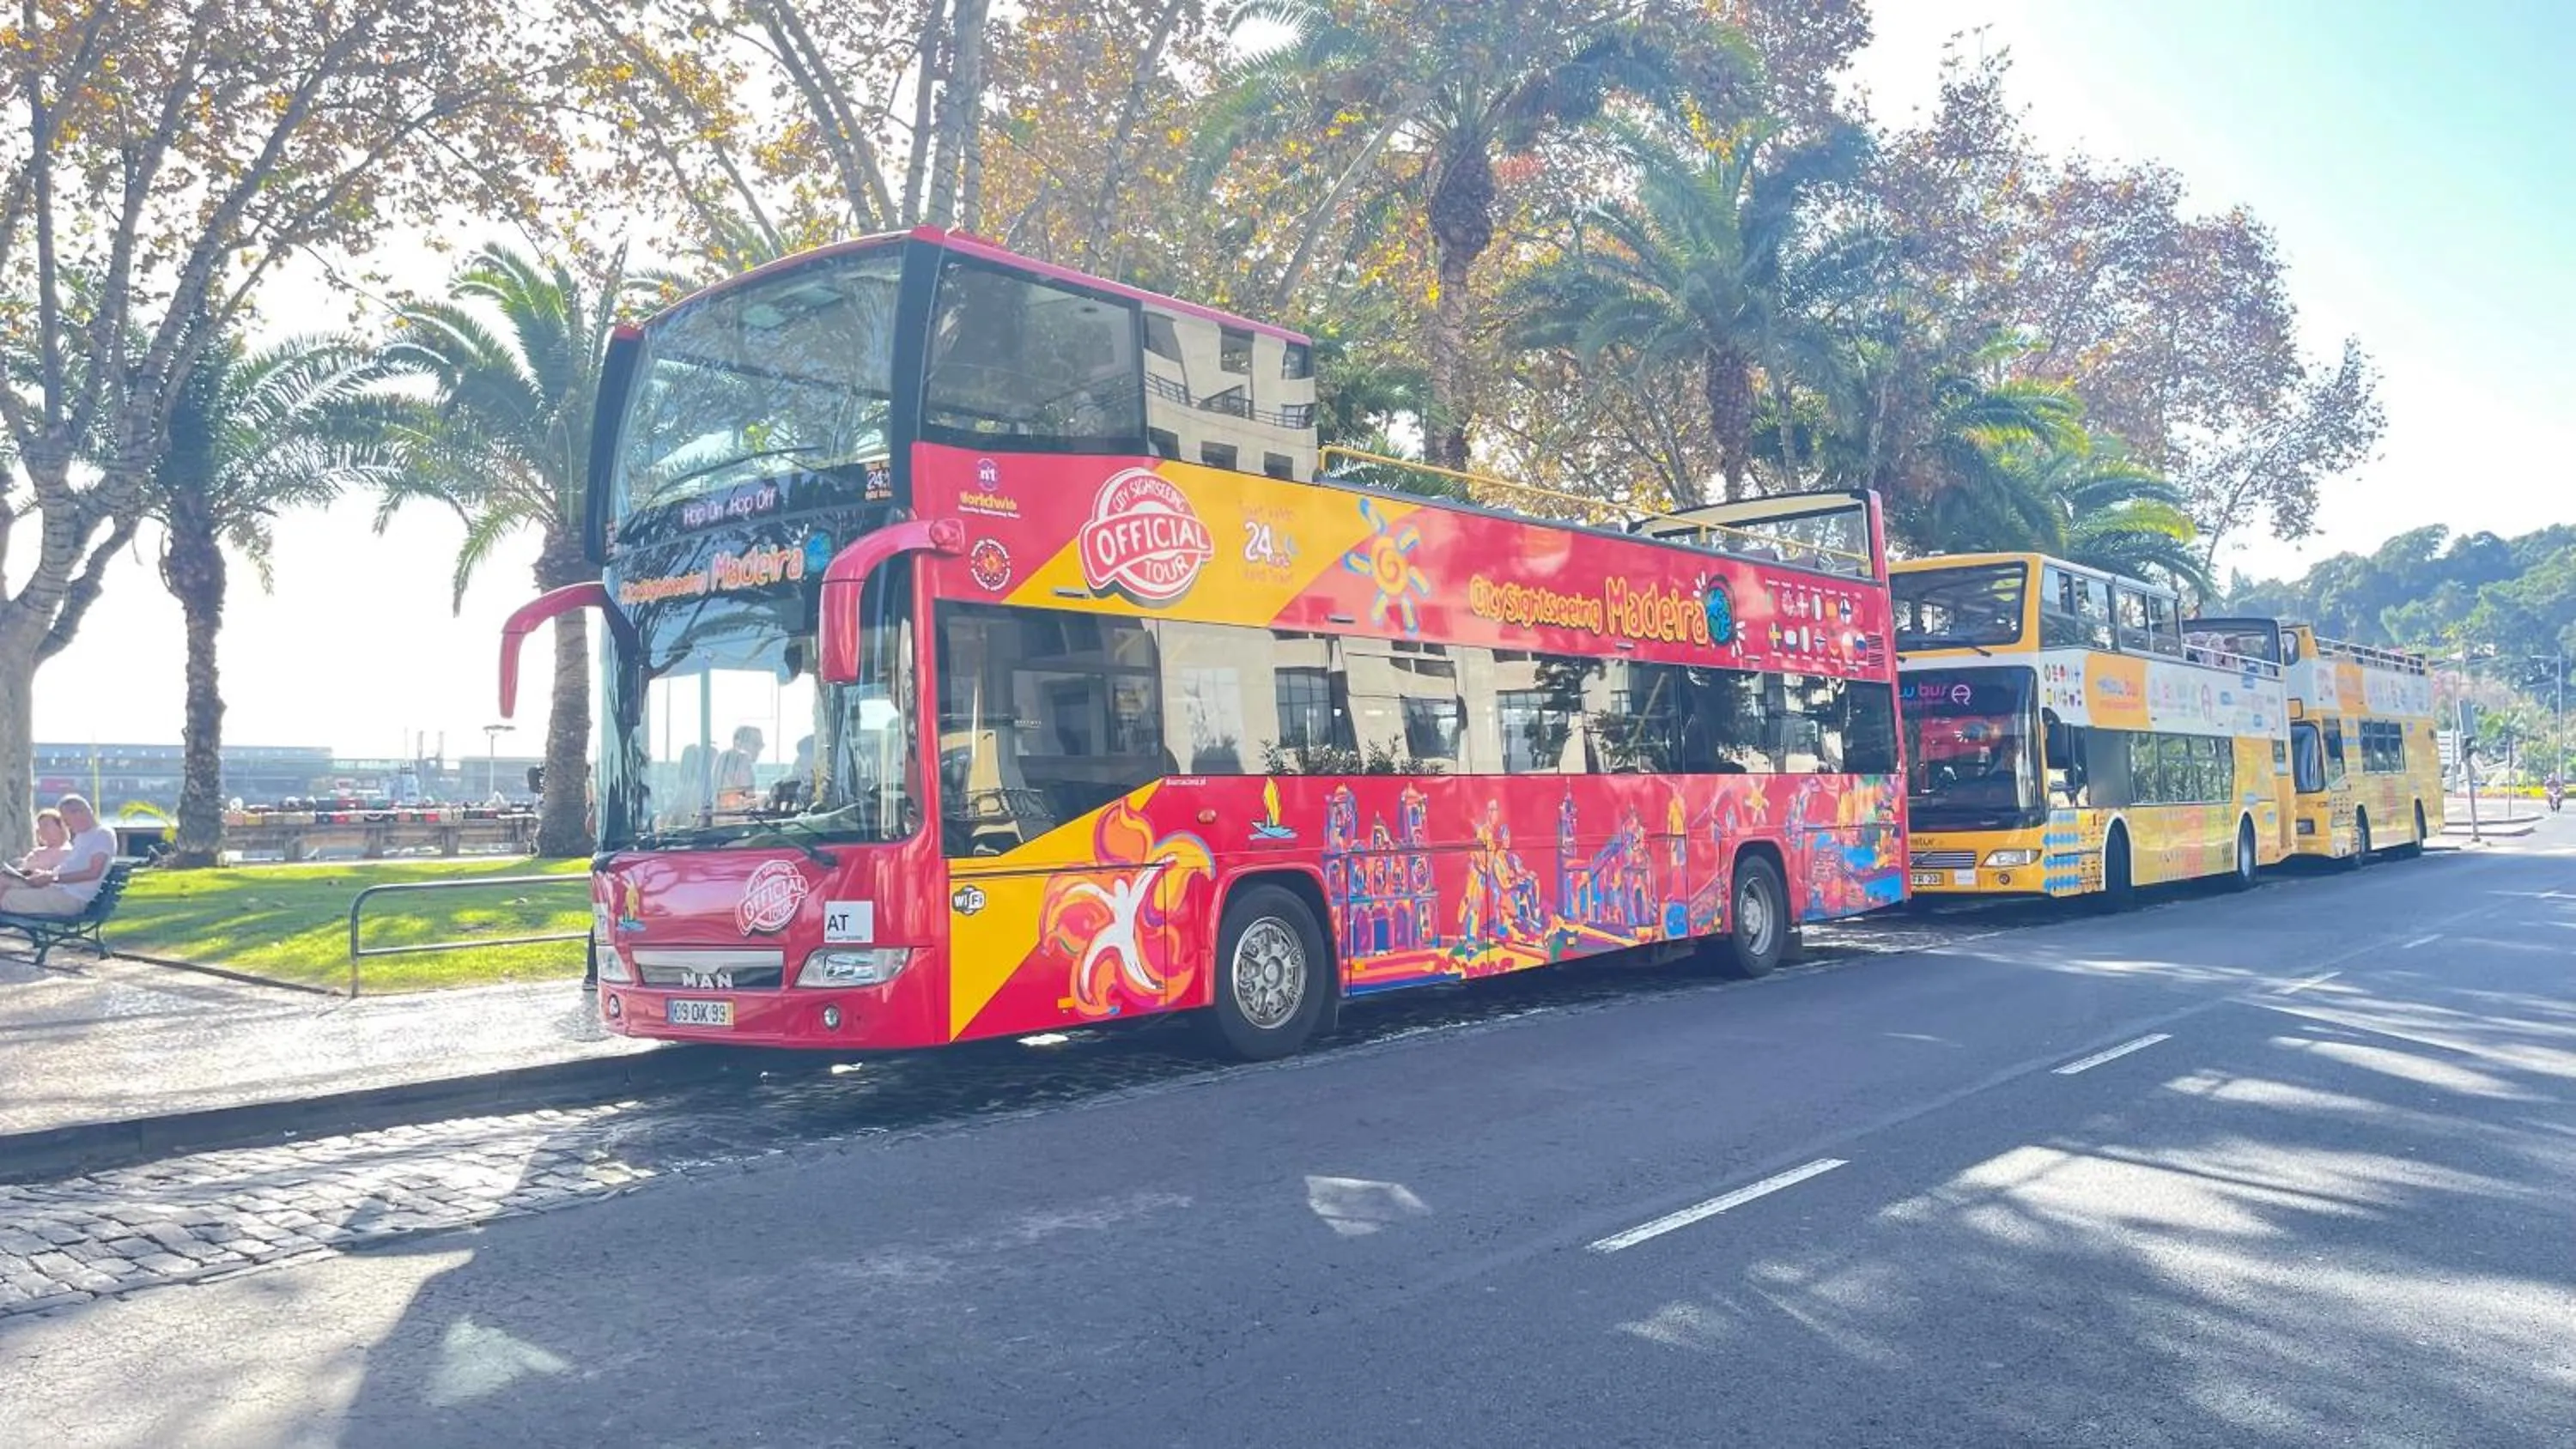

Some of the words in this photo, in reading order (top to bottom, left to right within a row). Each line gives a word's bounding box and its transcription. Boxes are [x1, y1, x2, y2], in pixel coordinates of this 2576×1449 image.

[756, 486, 776, 509] Off
[1112, 485, 1132, 512] CITY
[1129, 478, 1187, 513] SIGHTSEEING
[1096, 517, 1210, 567] OFFICIAL
[1243, 520, 1273, 562] 24
[709, 543, 805, 592] Madeira
[1144, 555, 1190, 583] TOUR
[1605, 576, 1709, 645] Madeira
[744, 877, 805, 921] OFFICIAL
[827, 914, 849, 931] AT
[681, 973, 733, 989] MAN
